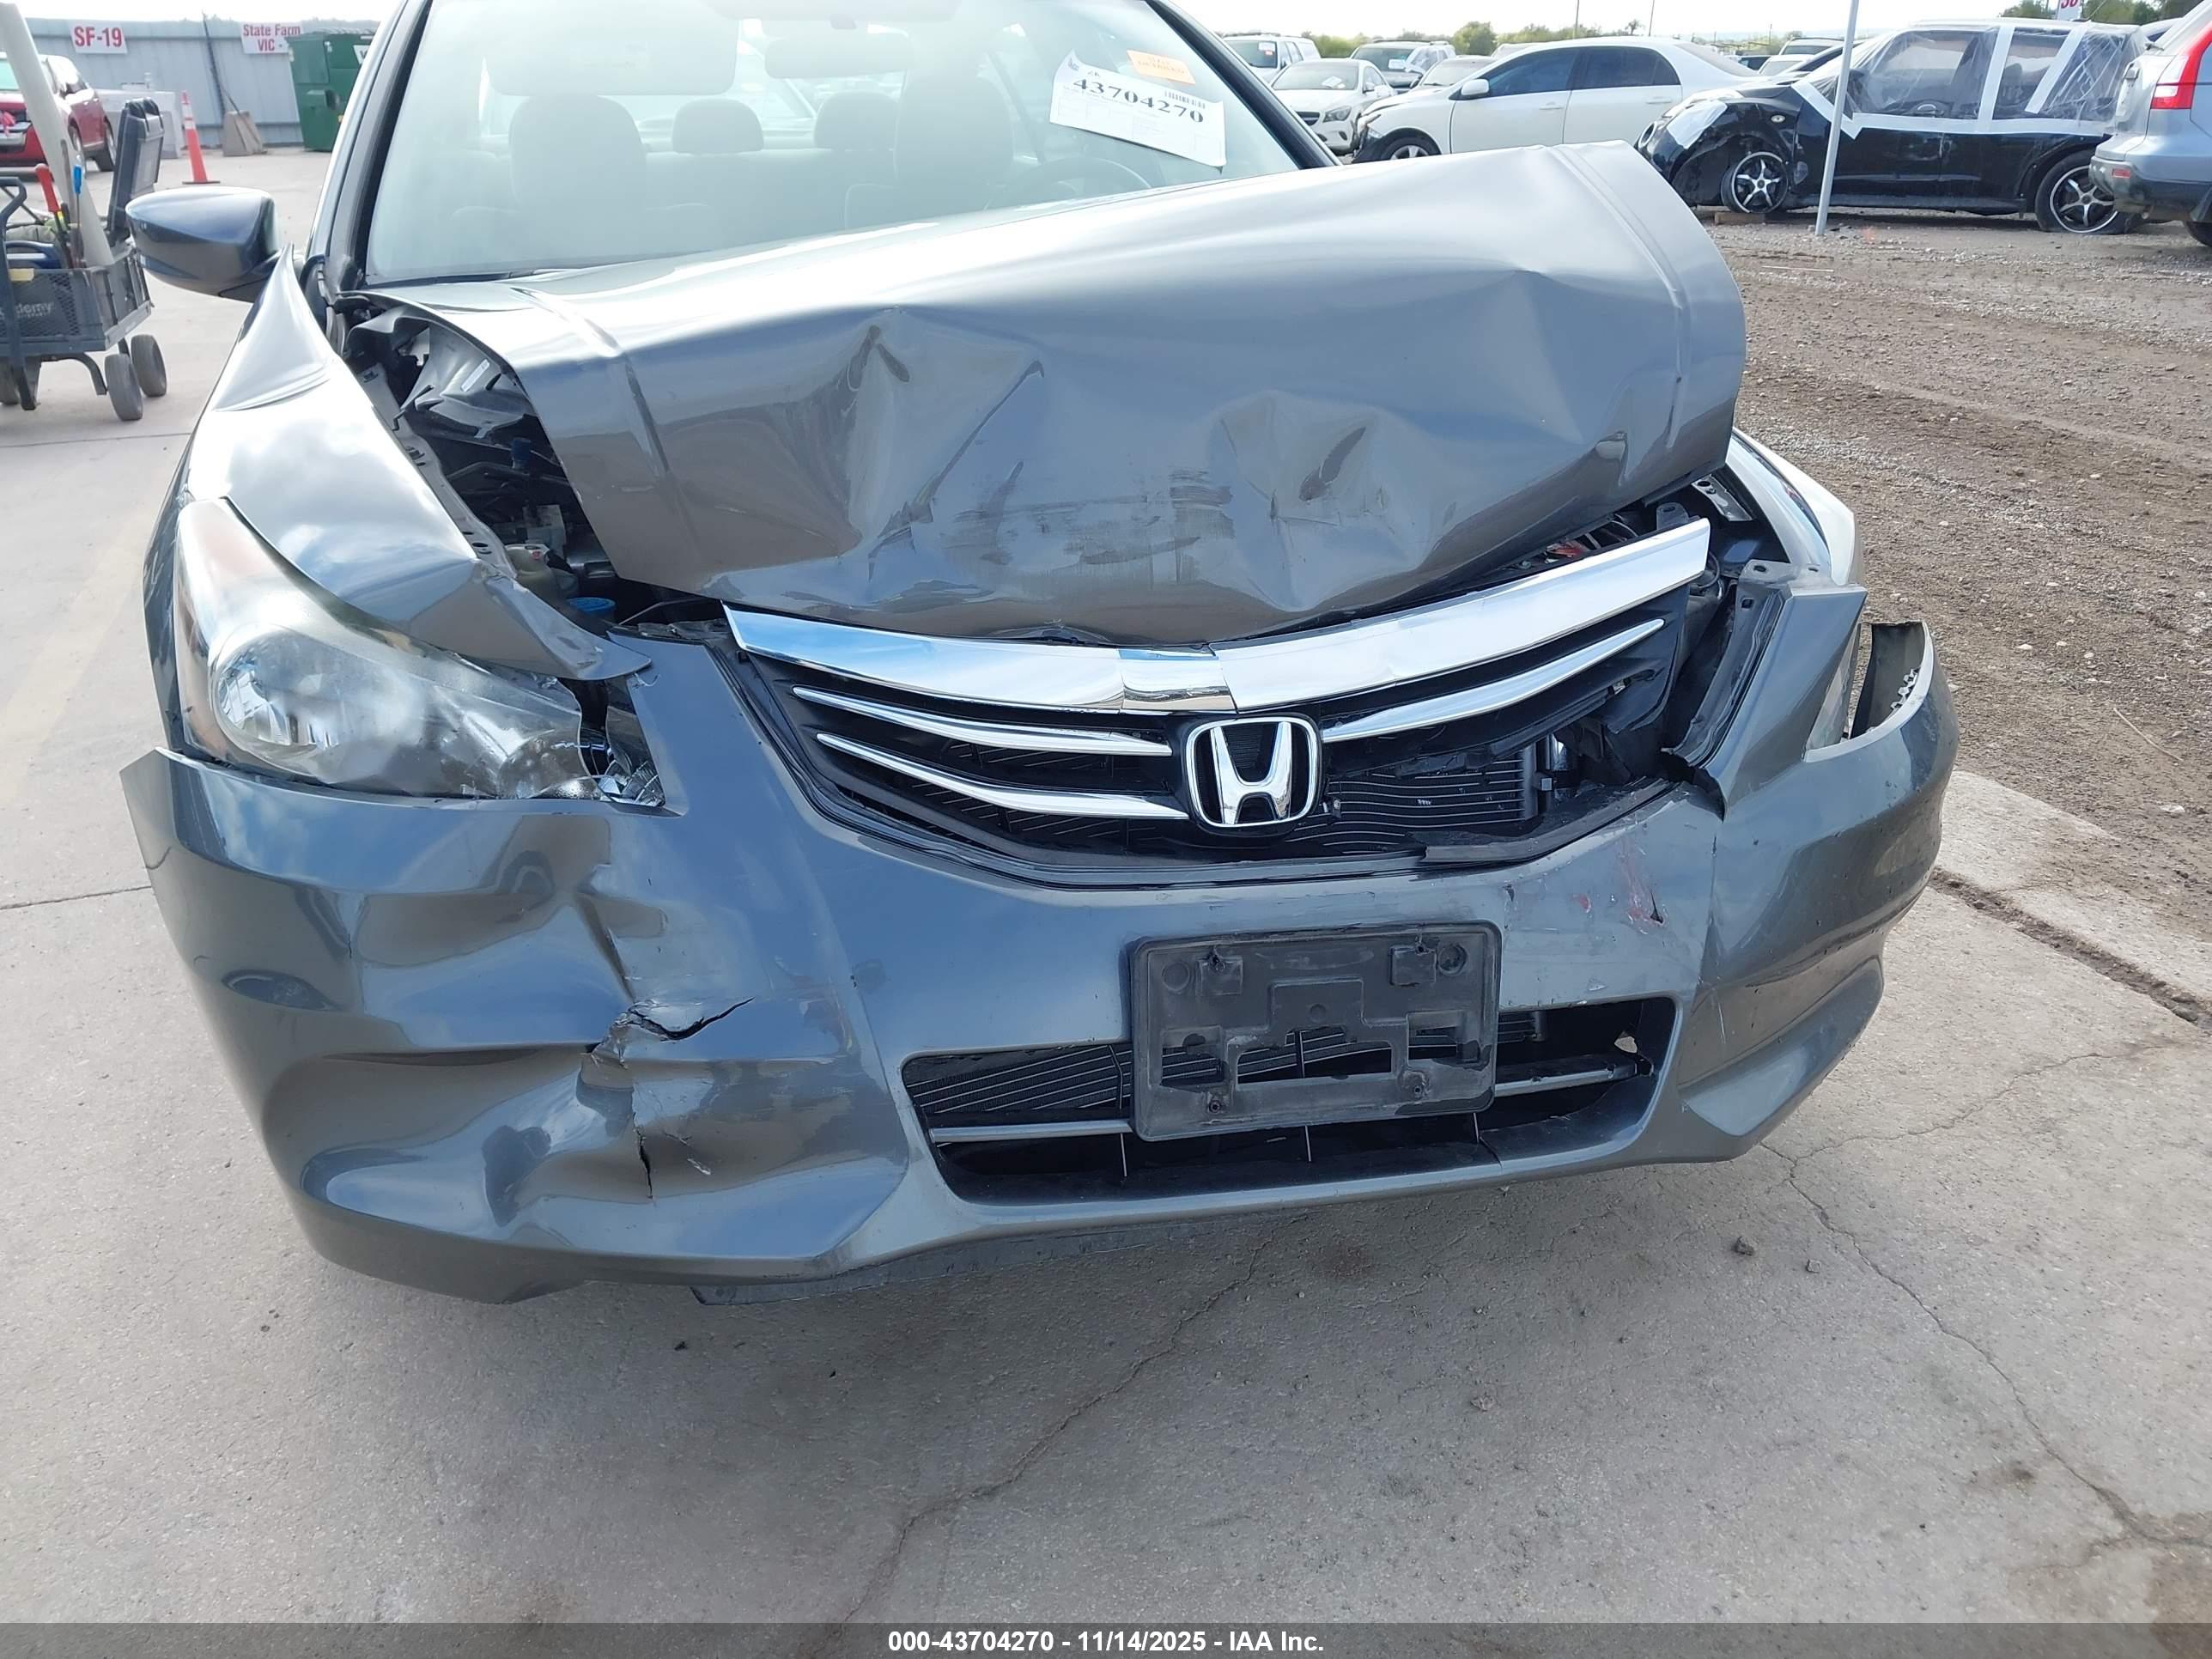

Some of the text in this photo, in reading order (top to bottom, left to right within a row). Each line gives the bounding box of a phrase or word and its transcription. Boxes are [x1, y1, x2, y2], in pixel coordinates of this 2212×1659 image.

[74, 26, 122, 47] SF-19
[243, 23, 301, 36] State Farm
[258, 39, 275, 52] VIC
[1073, 79, 1204, 123] 43704270
